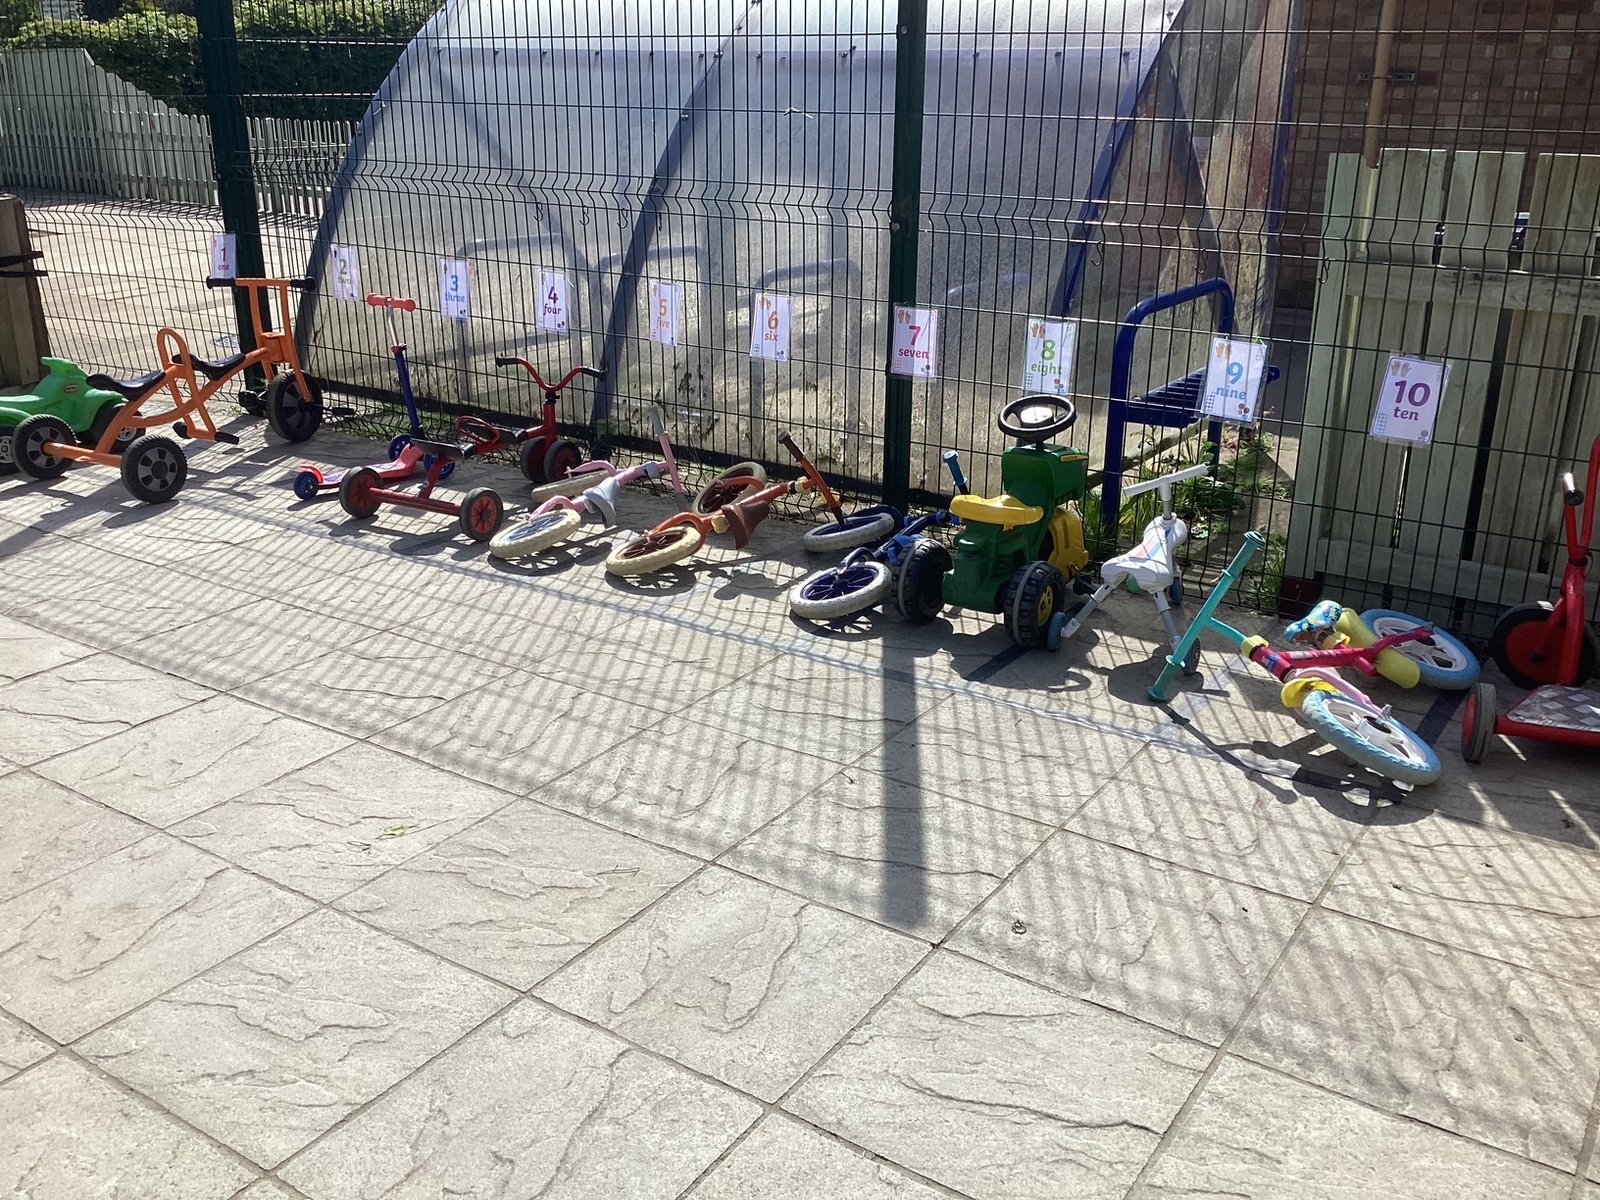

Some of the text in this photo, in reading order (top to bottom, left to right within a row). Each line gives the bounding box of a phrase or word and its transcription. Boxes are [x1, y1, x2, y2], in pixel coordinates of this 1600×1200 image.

[340, 261, 347, 274] 2
[450, 275, 458, 292] 3
[445, 291, 465, 303] three
[548, 286, 558, 304] 4
[544, 303, 562, 315] four
[659, 299, 667, 316] 5
[656, 316, 670, 329] five
[767, 311, 778, 329] 6
[764, 331, 778, 342] six
[909, 326, 921, 345] 7
[898, 348, 929, 359] seven
[1041, 340, 1055, 360] 8
[1031, 362, 1062, 377] eight
[1227, 361, 1244, 384] 9
[1216, 385, 1247, 400] nine
[1394, 380, 1430, 407] 10
[1393, 406, 1419, 421] ten
